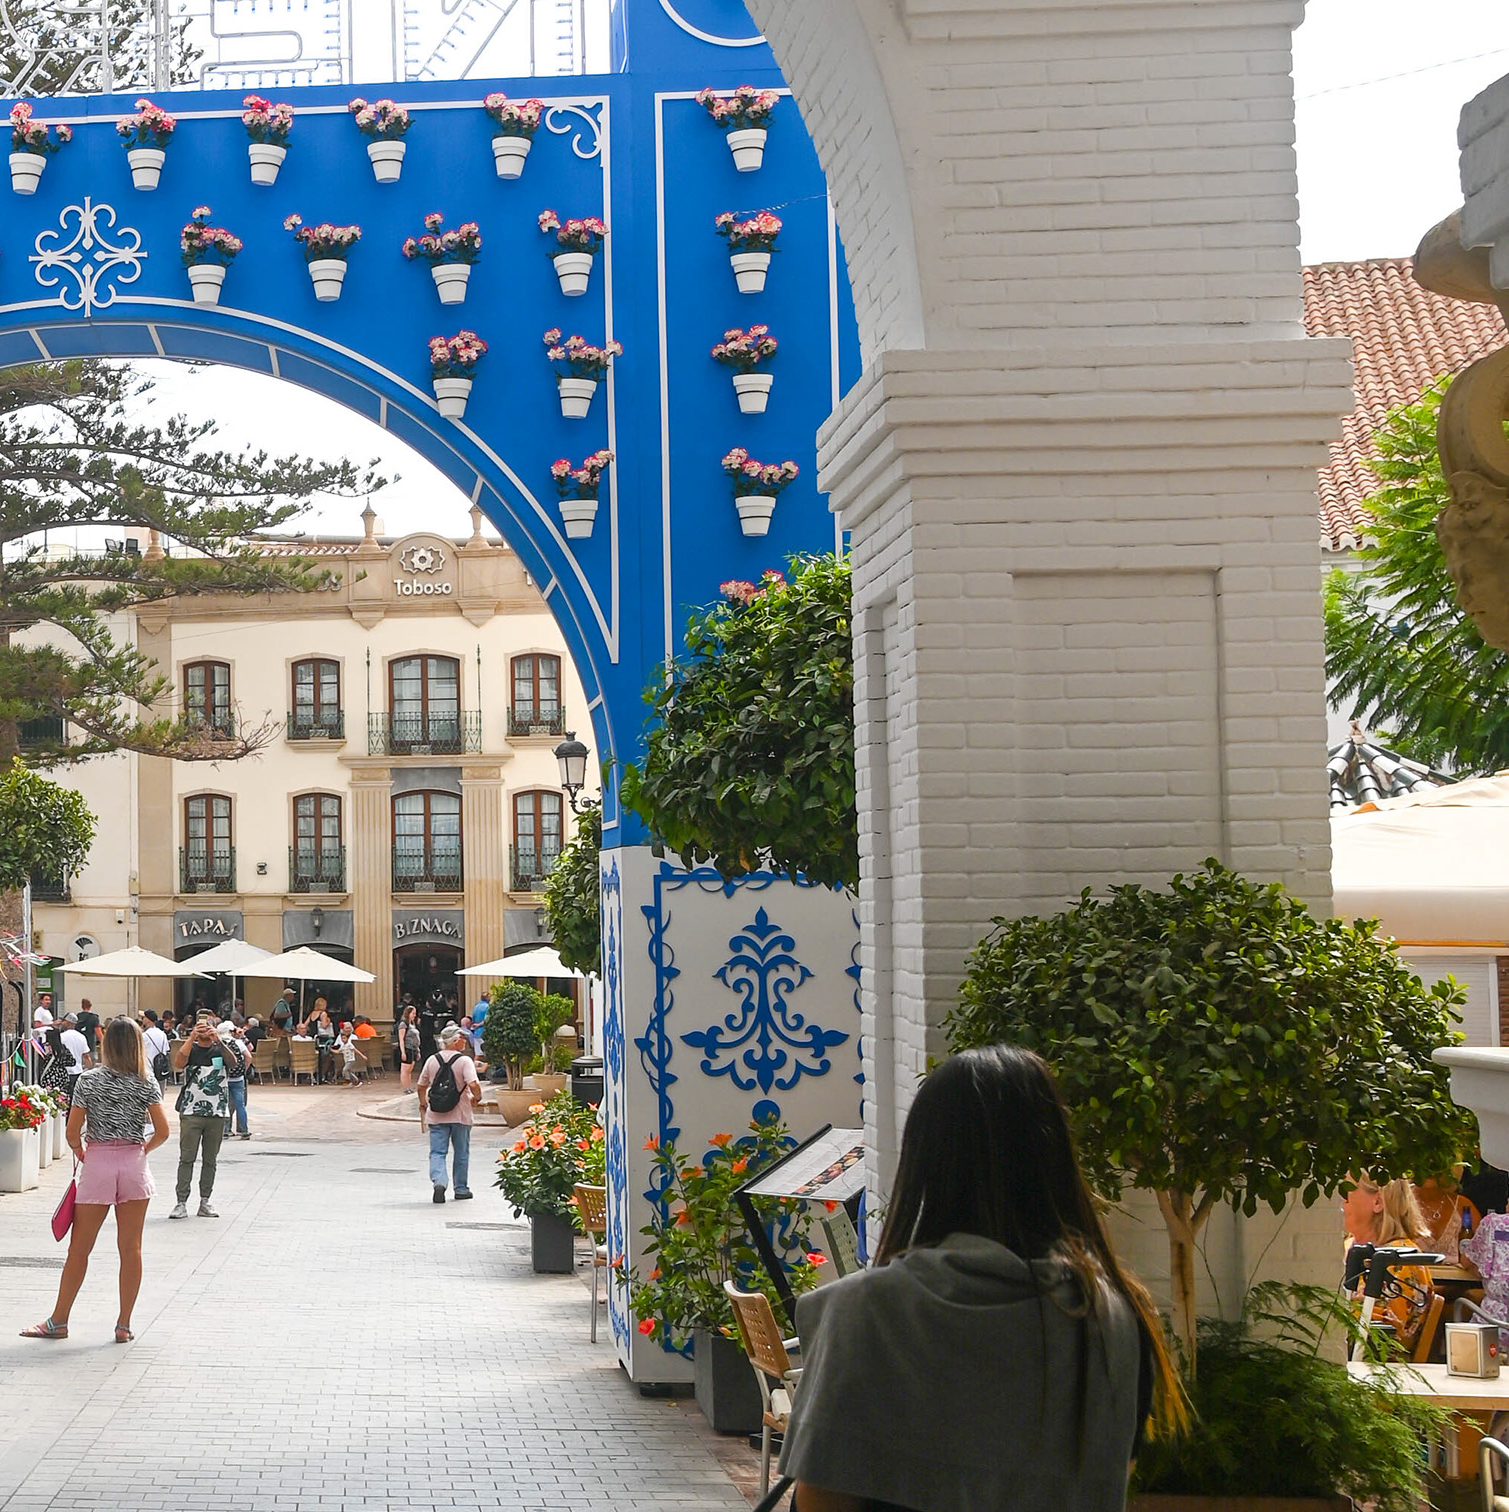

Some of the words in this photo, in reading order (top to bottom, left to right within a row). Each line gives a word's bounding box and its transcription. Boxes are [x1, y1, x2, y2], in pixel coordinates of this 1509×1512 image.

[393, 578, 452, 596] Toboso
[179, 918, 237, 937] TAPAS
[394, 917, 462, 939] BIZNAGA
